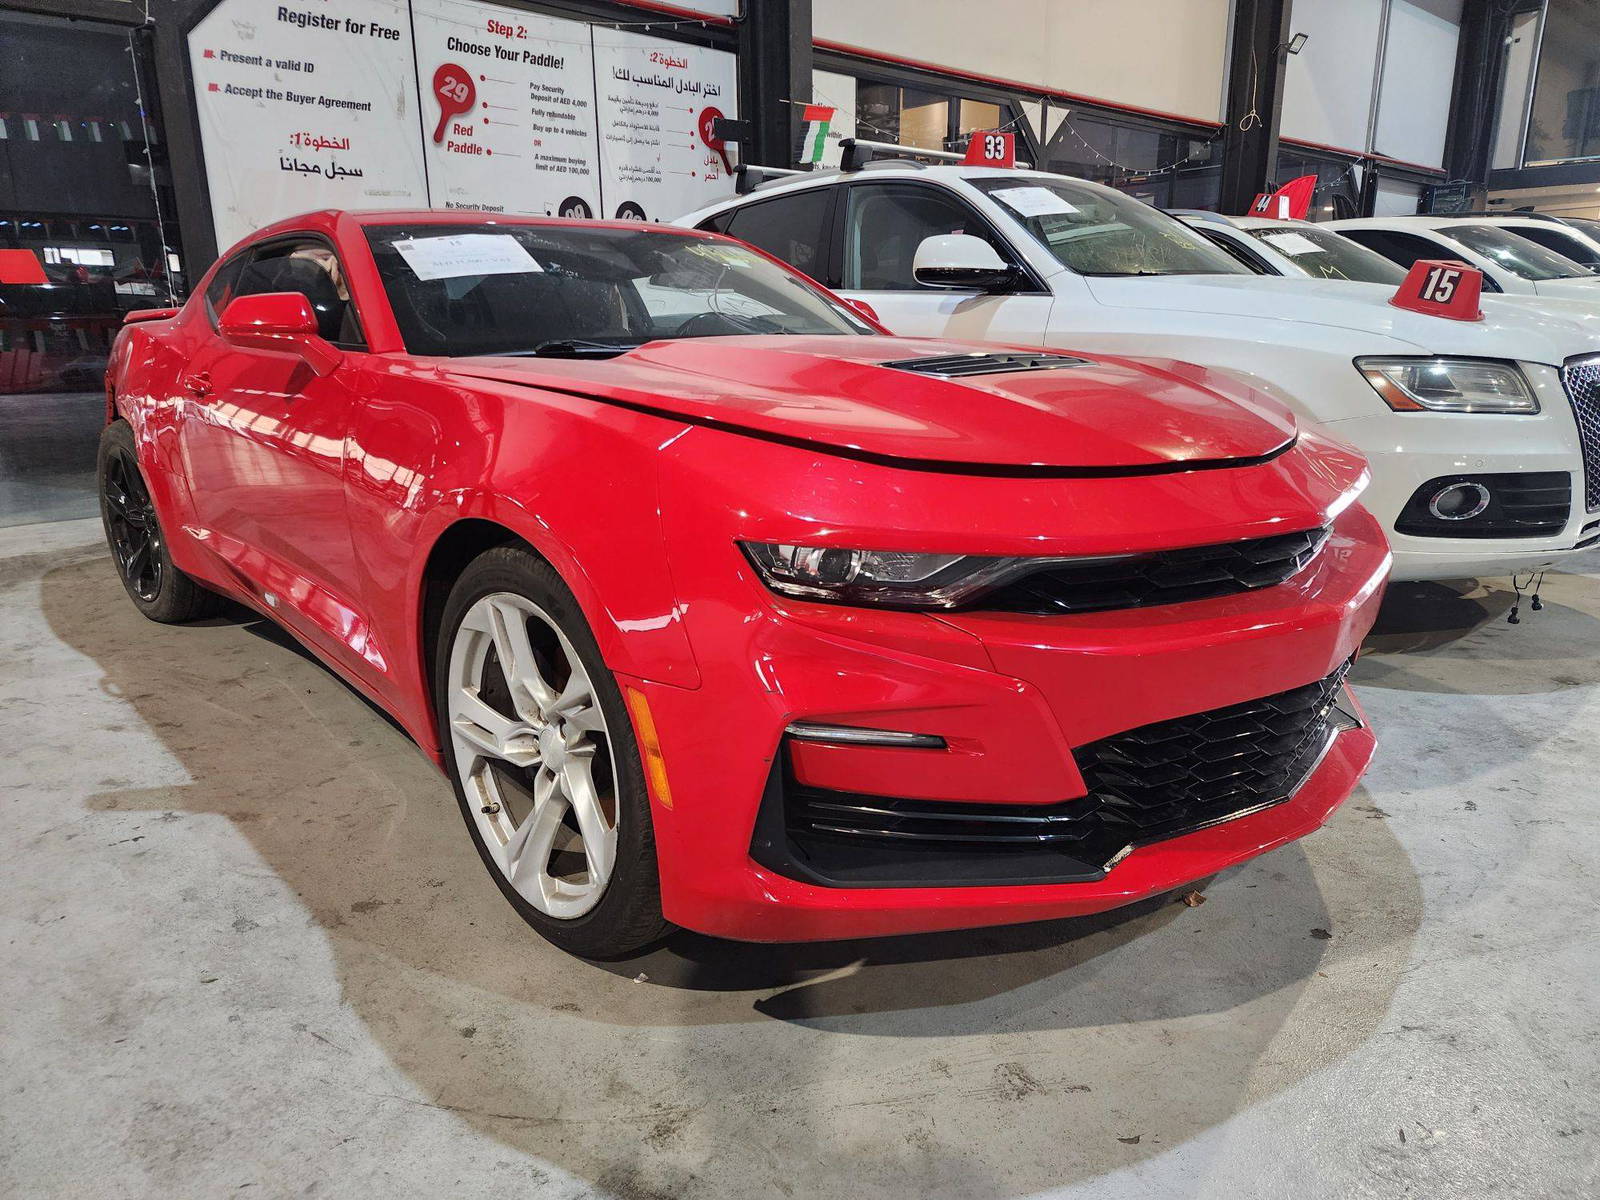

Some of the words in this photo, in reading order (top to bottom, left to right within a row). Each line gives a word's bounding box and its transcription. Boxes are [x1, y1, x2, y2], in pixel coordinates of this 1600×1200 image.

[278, 6, 341, 30] Register
[345, 18, 365, 35] for
[370, 23, 400, 41] Free
[487, 19, 513, 39] Step
[517, 25, 528, 39] 2:
[447, 36, 491, 57] Choose
[494, 45, 520, 62] Your
[523, 51, 564, 70] Paddle!
[220, 50, 263, 67] Present
[266, 58, 272, 67] a
[275, 59, 301, 72] valid
[304, 63, 315, 73] ID
[530, 82, 541, 91] Pay
[542, 84, 564, 95] Security
[632, 73, 674, 89] المناسب
[675, 80, 701, 96] البادل
[224, 83, 263, 100] Accept
[266, 89, 283, 101] the
[286, 91, 316, 105] Buyer
[318, 96, 372, 112] Agreement
[440, 76, 469, 104] 29
[531, 93, 552, 103] Deposit
[703, 82, 721, 99] اختر
[532, 108, 545, 117] Fully
[453, 123, 474, 137] Red
[533, 123, 544, 132] Buy
[565, 129, 587, 137] vehicles
[447, 140, 483, 156] Paddle
[533, 139, 542, 147] OR
[985, 135, 1005, 160] 33
[540, 155, 567, 163] maximum
[568, 157, 587, 166] buying
[325, 161, 363, 180] سجل
[445, 201, 454, 209] No
[455, 202, 480, 212] Security
[481, 204, 504, 213] Deposit
[1256, 195, 1272, 212] 44
[1423, 267, 1460, 303] 15
